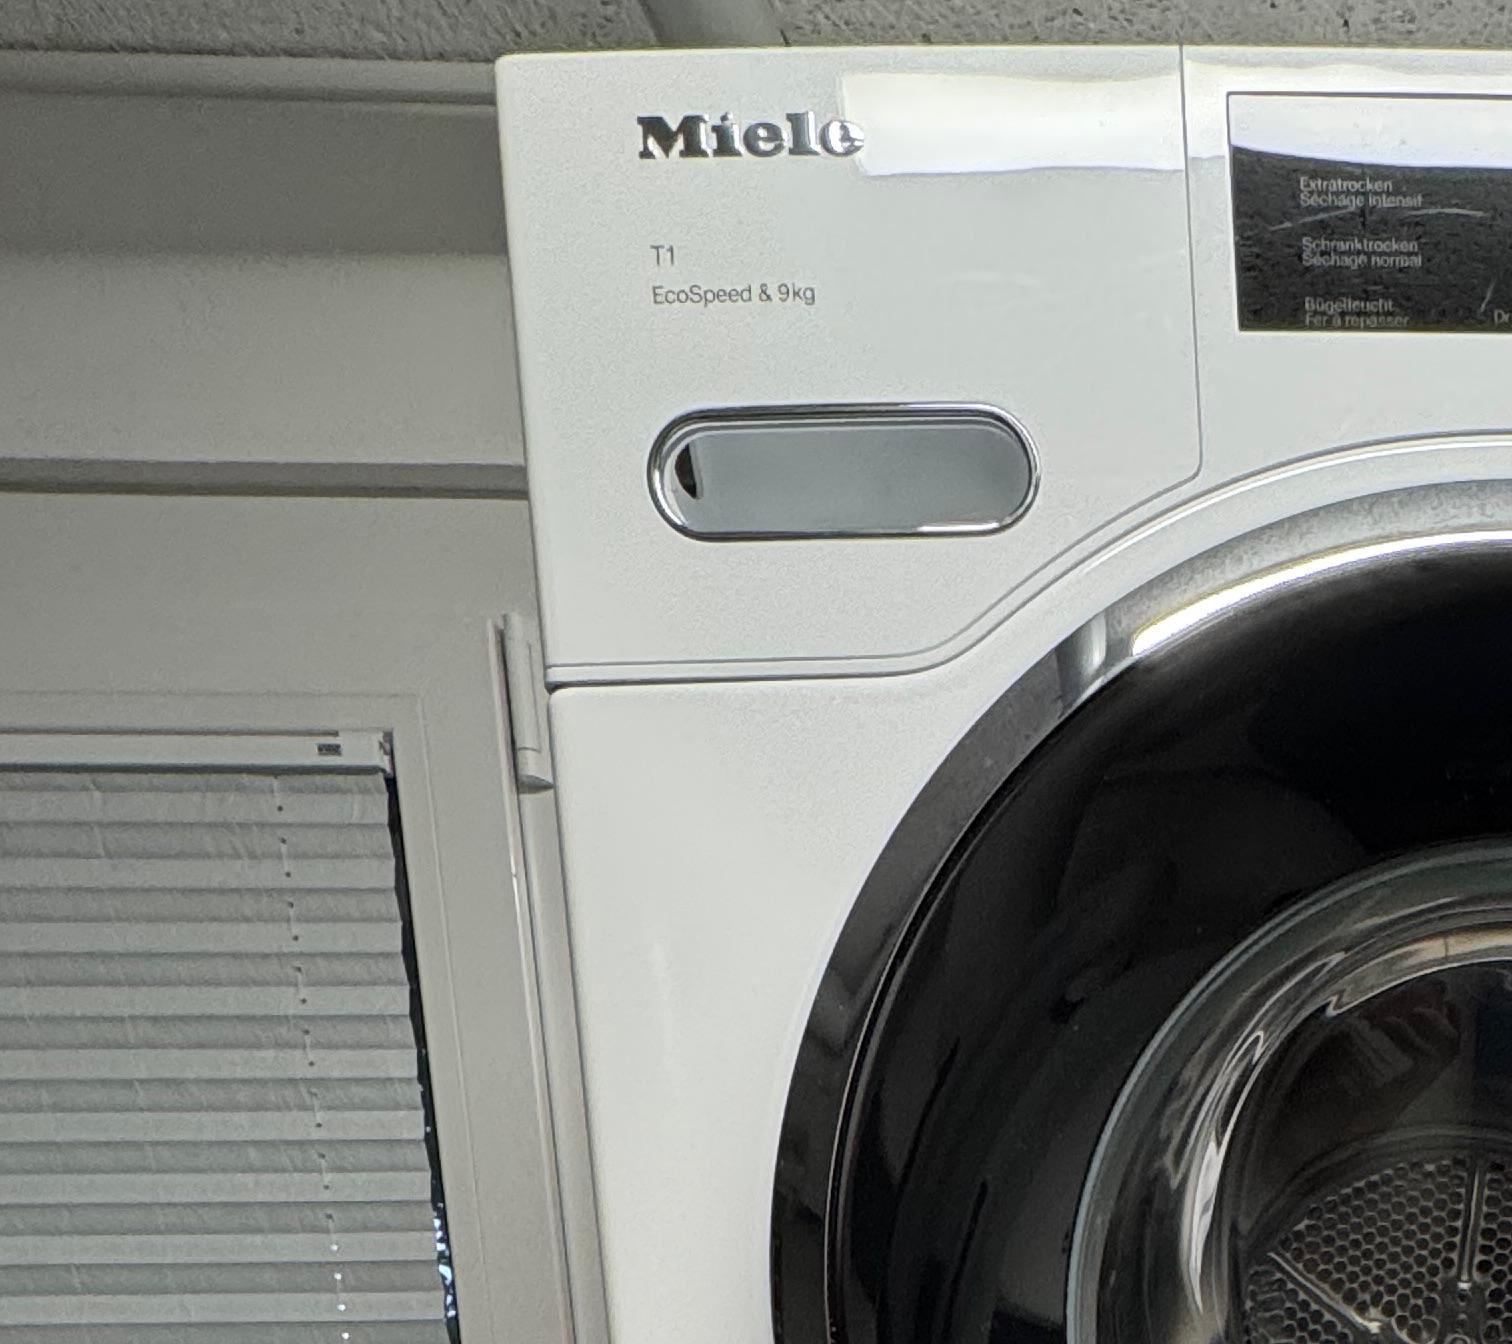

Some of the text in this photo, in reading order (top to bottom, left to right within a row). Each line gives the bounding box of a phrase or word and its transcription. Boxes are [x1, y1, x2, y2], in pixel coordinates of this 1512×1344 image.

[637, 110, 865, 160] Miele
[1300, 176, 1393, 193] Extratrocken
[650, 244, 675, 267] T1
[652, 283, 752, 307] EcoSpeed
[758, 282, 773, 302] &
